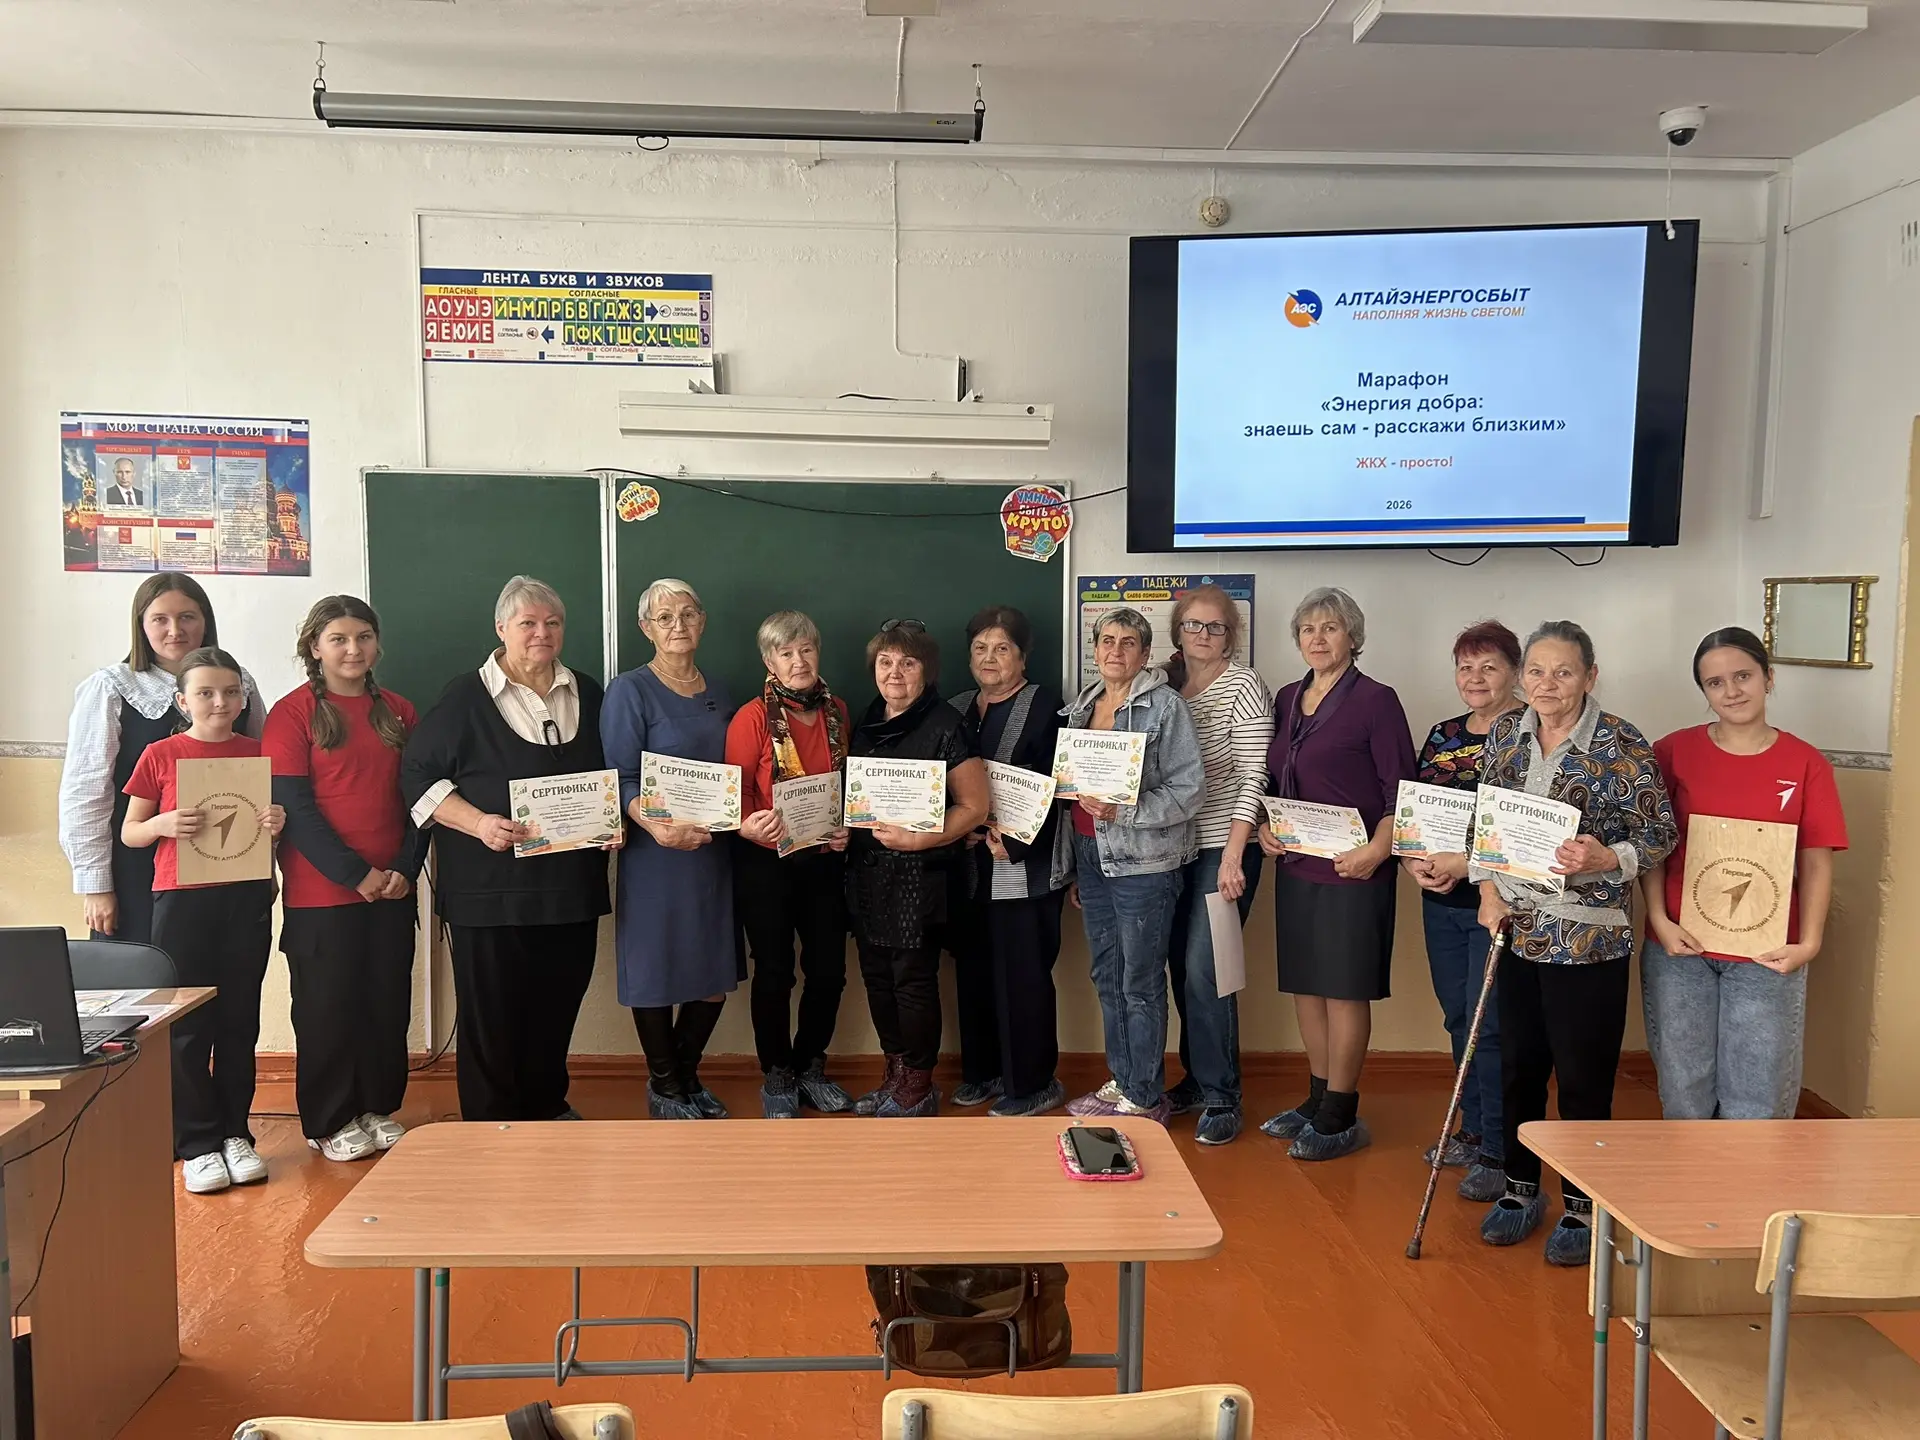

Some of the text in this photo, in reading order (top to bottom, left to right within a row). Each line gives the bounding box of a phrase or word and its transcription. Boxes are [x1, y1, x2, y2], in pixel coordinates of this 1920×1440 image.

[482, 272, 664, 288] ЛЕНТА БУКВ И ЗВУКОВ
[438, 286, 479, 295] ГЛАСНЫЕ
[568, 289, 620, 299] СОГЛАСНЫЕ
[1334, 287, 1531, 307] АЛТАЙЭНЕРГОСБЫТ
[1291, 303, 1317, 315] АЭС
[1352, 306, 1526, 321] НАПОЛНЯЯ ЖИЗНЬ СВЕТОМ!
[1357, 371, 1449, 390] Марафон
[1320, 393, 1484, 415] «Энергия добра:
[105, 421, 264, 437] МОЯ СТРАНА РОССИЯ
[1243, 422, 1314, 437] знаешь
[1320, 422, 1356, 435] сам
[1374, 418, 1466, 437] расскажи
[1472, 416, 1566, 433] близким»
[1356, 457, 1387, 468] ЖКХ
[1400, 456, 1453, 470] просто!
[1386, 500, 1412, 510] 2026
[1007, 512, 1067, 531] КРУТО!
[1142, 577, 1187, 589] ПАДЕЖИ
[1073, 739, 1129, 751] СЕРТИФИКАТ
[660, 765, 722, 782] СЕРТИФИКАТ
[865, 767, 928, 780] СЕРТИФИКАТ
[990, 771, 1041, 793] СЕРТИФИКАТ
[531, 782, 599, 799] СЕРТИФИКАТ
[783, 783, 827, 801] СЕРТИФИКАТ
[222, 792, 257, 808] АЛТАЙСКИЙ
[1418, 794, 1476, 813] СЕРТИФИК
[1280, 802, 1342, 818] СЕРТИФИКАТ
[1499, 800, 1568, 828] СЕРТИФИКАТ
[222, 841, 256, 862] АЛТАЙСКИЙ
[1704, 857, 1734, 871] ВЫСОТЕ!
[1735, 857, 1774, 881] АЛТАЙСКИЙ
[1722, 868, 1753, 878] Первые
[1699, 910, 1728, 931] ВЫСОТЕ!
[1728, 917, 1770, 933] АЛТАЙСКИЙ
